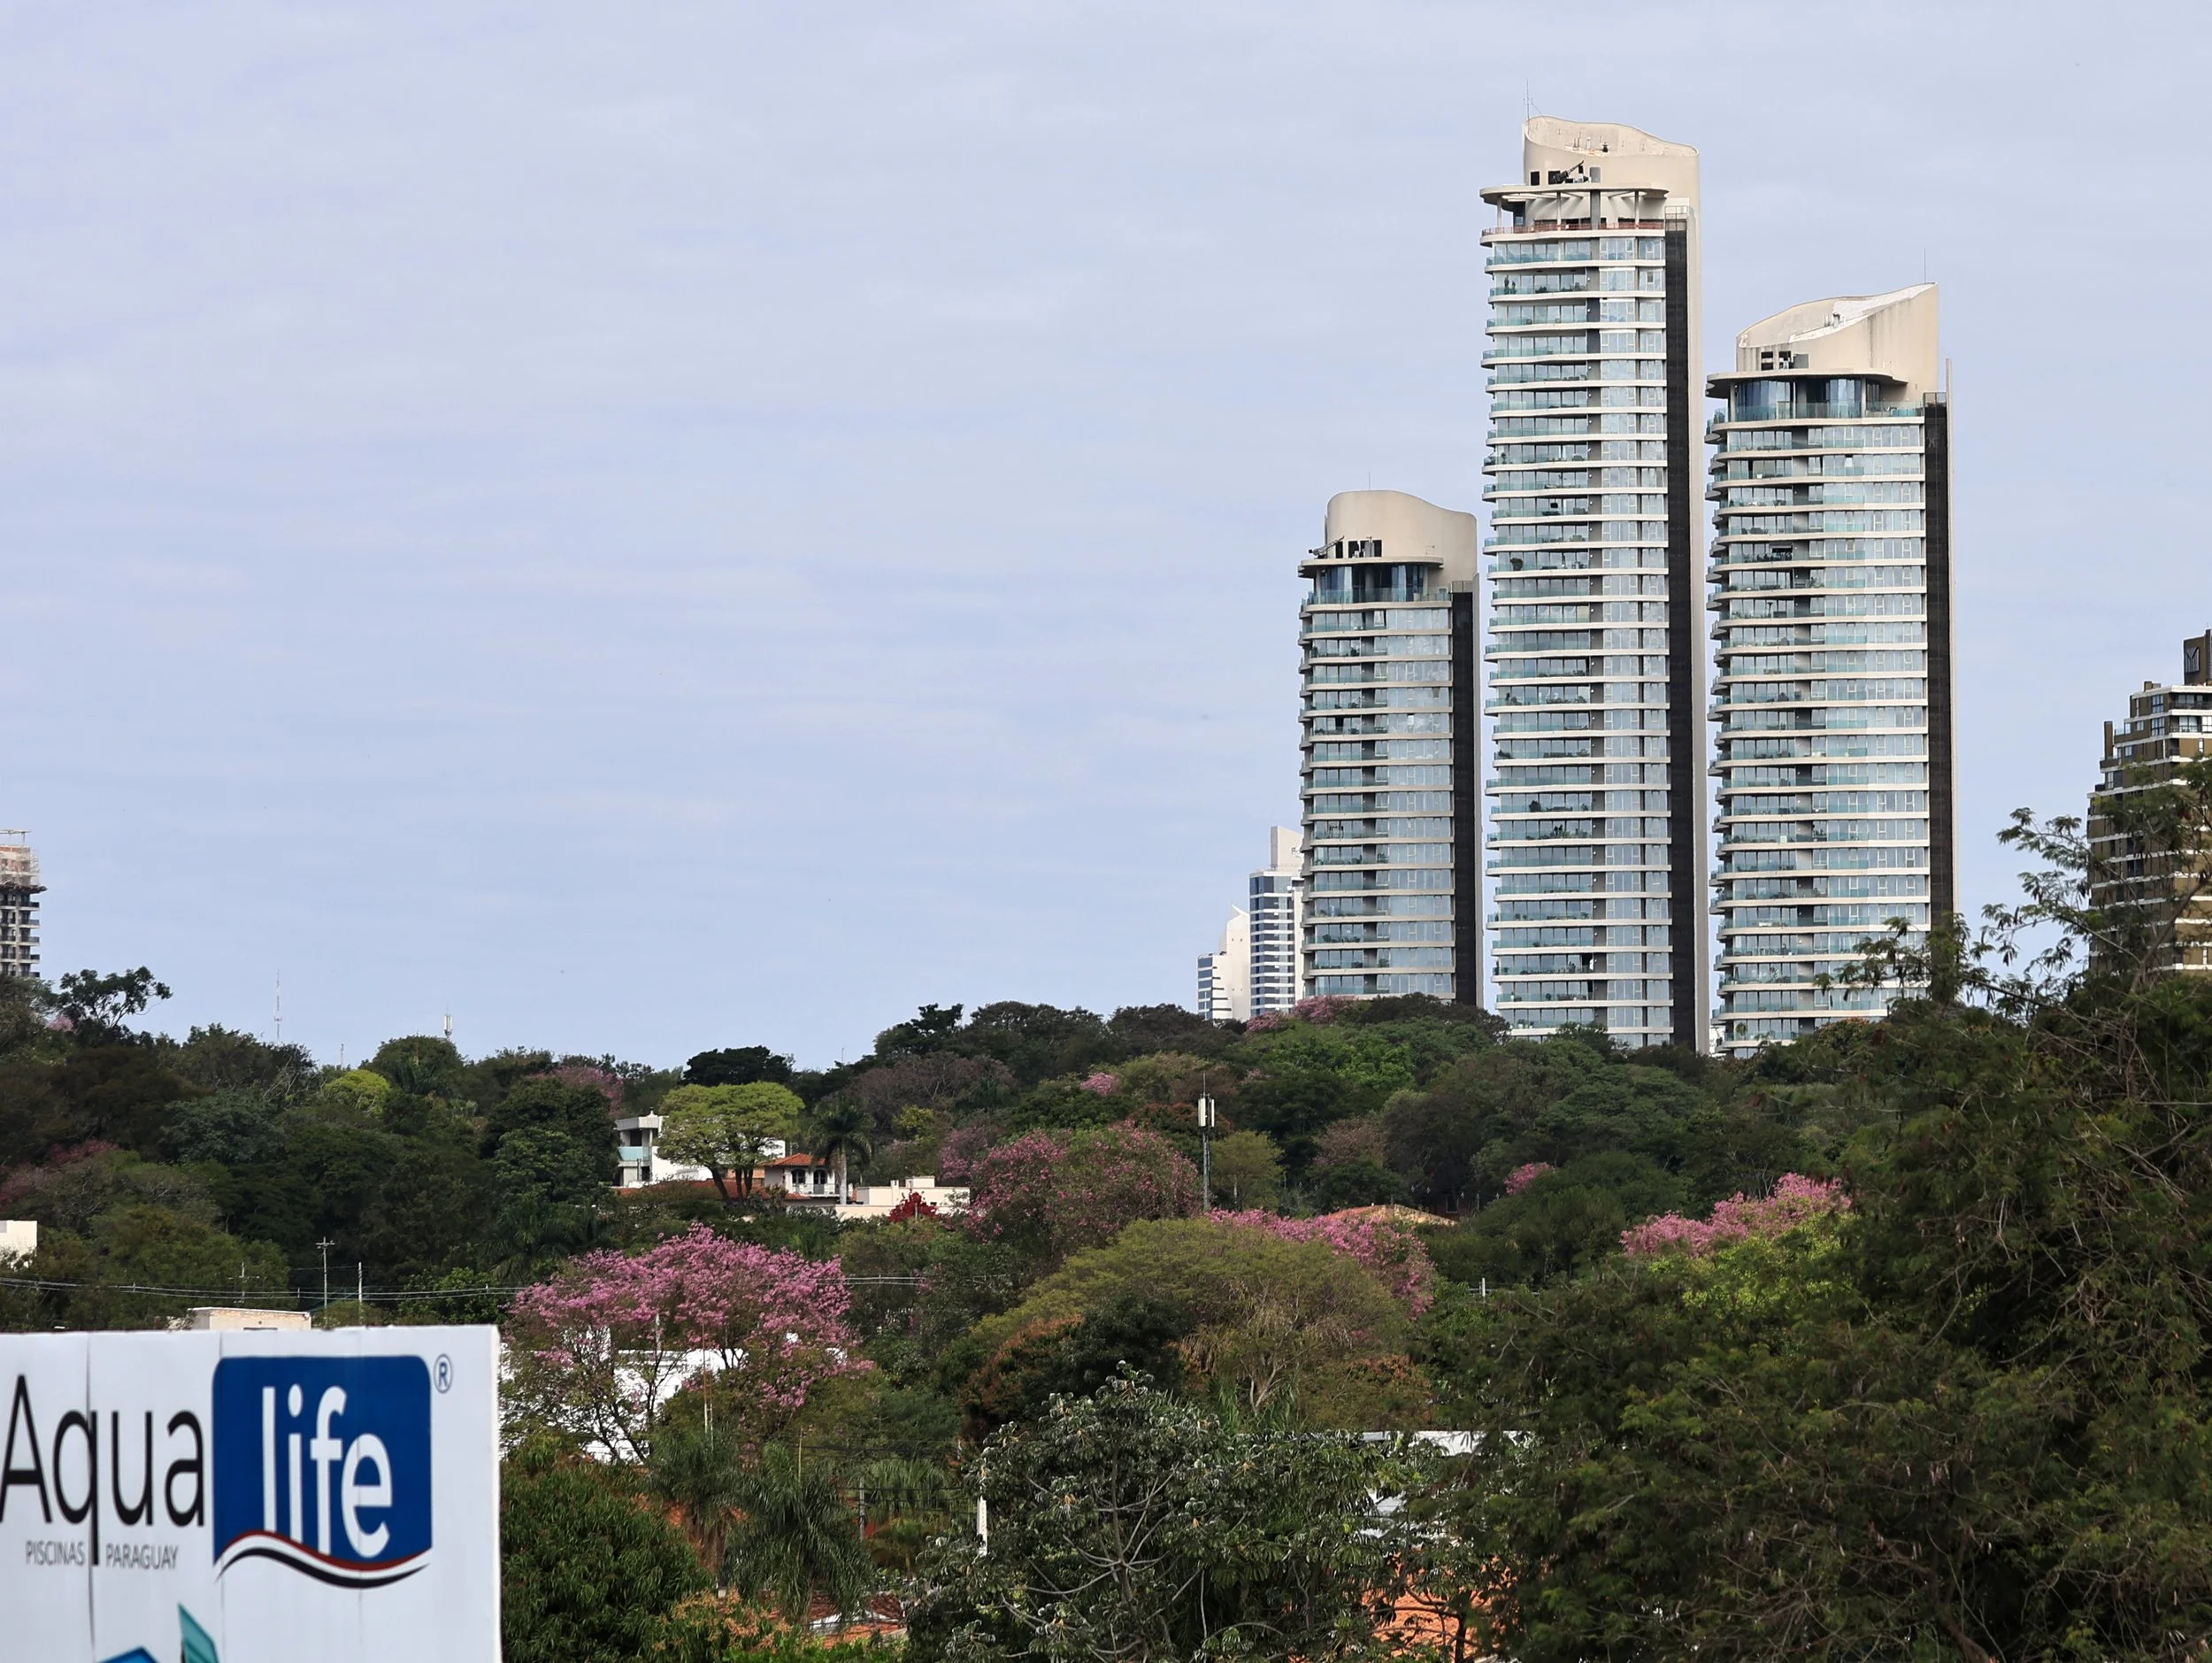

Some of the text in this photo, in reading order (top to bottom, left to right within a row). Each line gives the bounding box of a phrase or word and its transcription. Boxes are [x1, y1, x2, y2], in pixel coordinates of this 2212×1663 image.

[0, 1374, 205, 1567] Aqua
[262, 1384, 393, 1559] life
[25, 1540, 179, 1570] PISCINAS PARAGUAY
